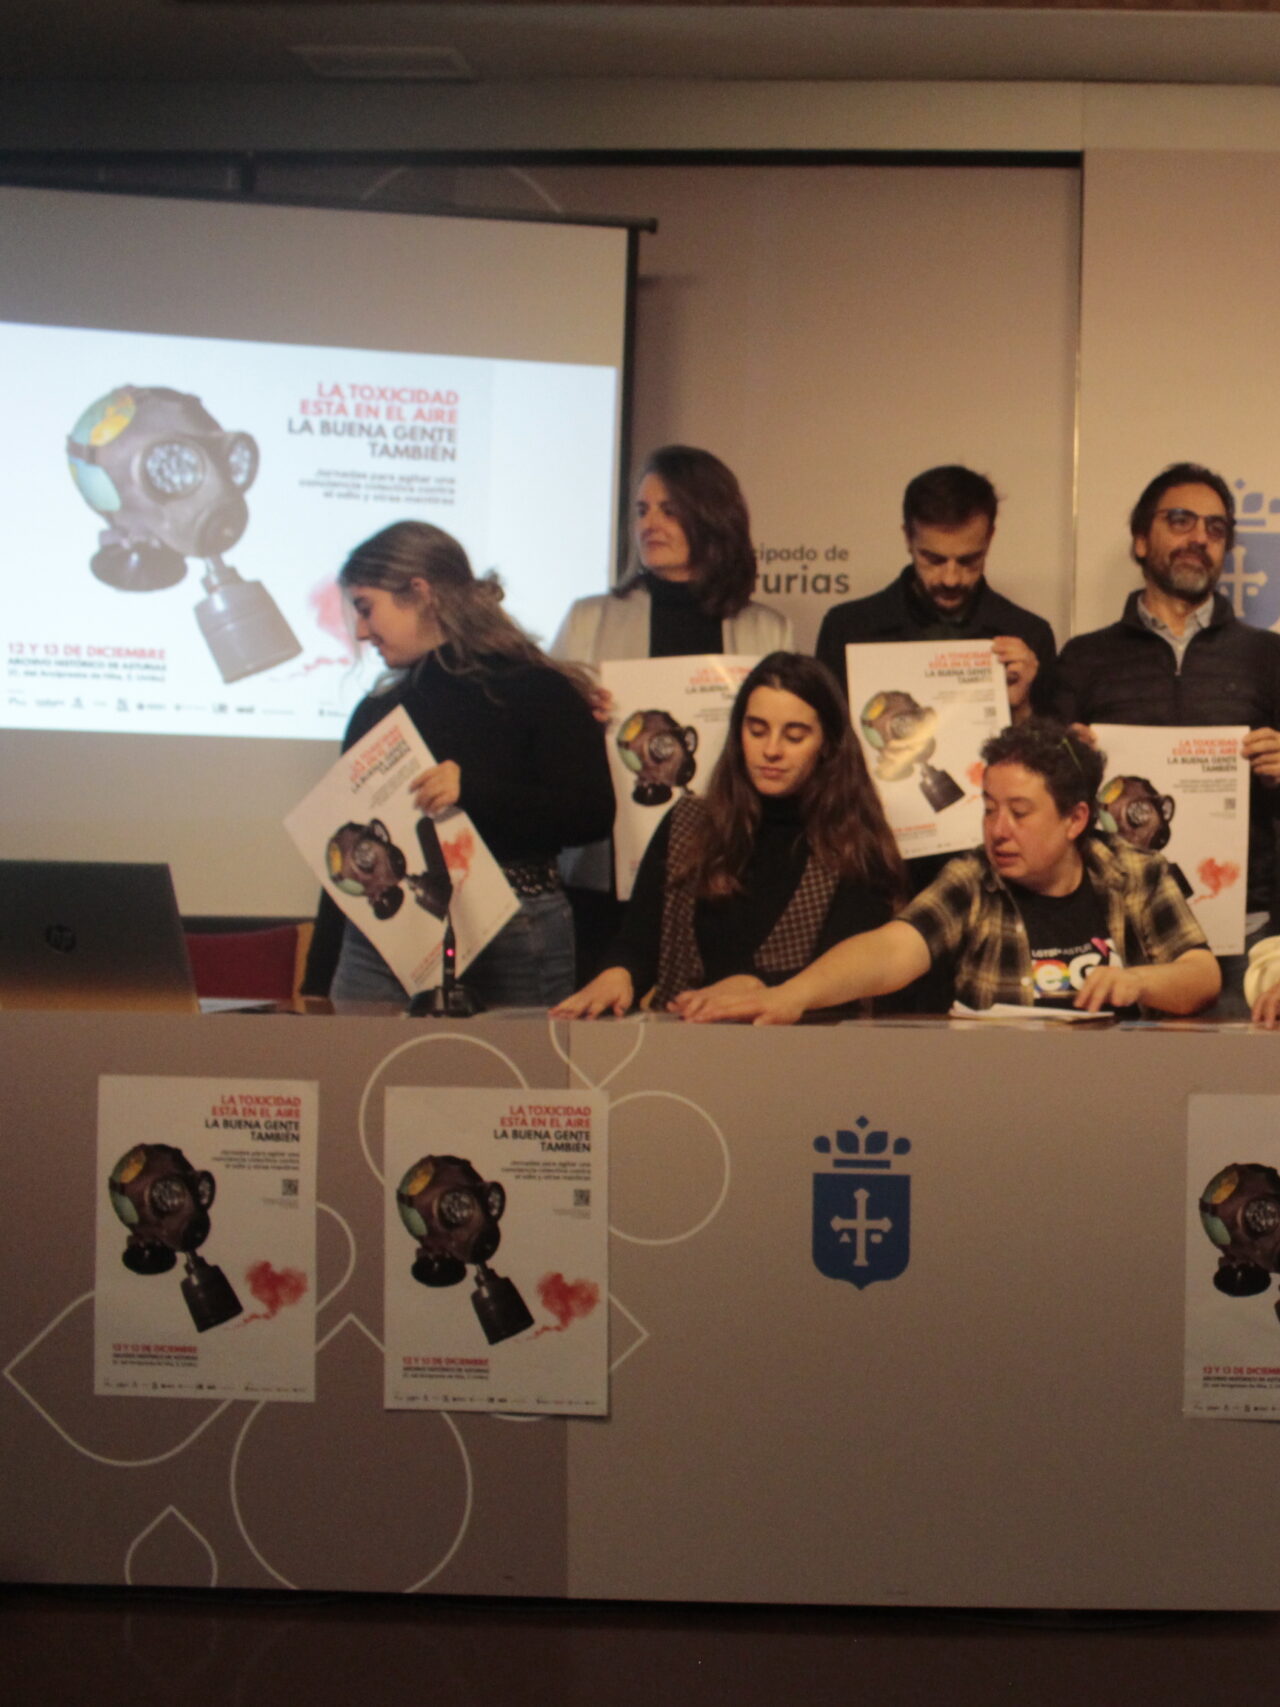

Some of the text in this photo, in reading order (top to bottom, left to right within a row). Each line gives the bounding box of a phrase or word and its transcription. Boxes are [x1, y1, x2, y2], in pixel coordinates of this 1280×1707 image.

[317, 382, 460, 405] LA TOXICIDAD
[354, 403, 380, 419] EN
[386, 405, 406, 421] EL
[412, 408, 458, 424] AIRE
[287, 418, 457, 443] LA BUENA GENTE
[368, 441, 457, 462] TAMBIÉN
[824, 544, 849, 561] de
[757, 564, 850, 594] urias
[221, 1094, 301, 1107] LA TOXICIDAD
[242, 1107, 257, 1117] EN
[275, 1108, 301, 1118] AIRE
[510, 1105, 592, 1116] LA TOXICIDAD
[205, 1118, 299, 1130] LA BUENA GENTE
[531, 1118, 546, 1127] EN
[550, 1118, 561, 1128] EL
[565, 1118, 591, 1128] AIRE
[251, 1130, 300, 1142] TAMBIÉN
[494, 1129, 591, 1140] LA BUENA GENTE
[540, 1140, 591, 1152] TAMBIÉN
